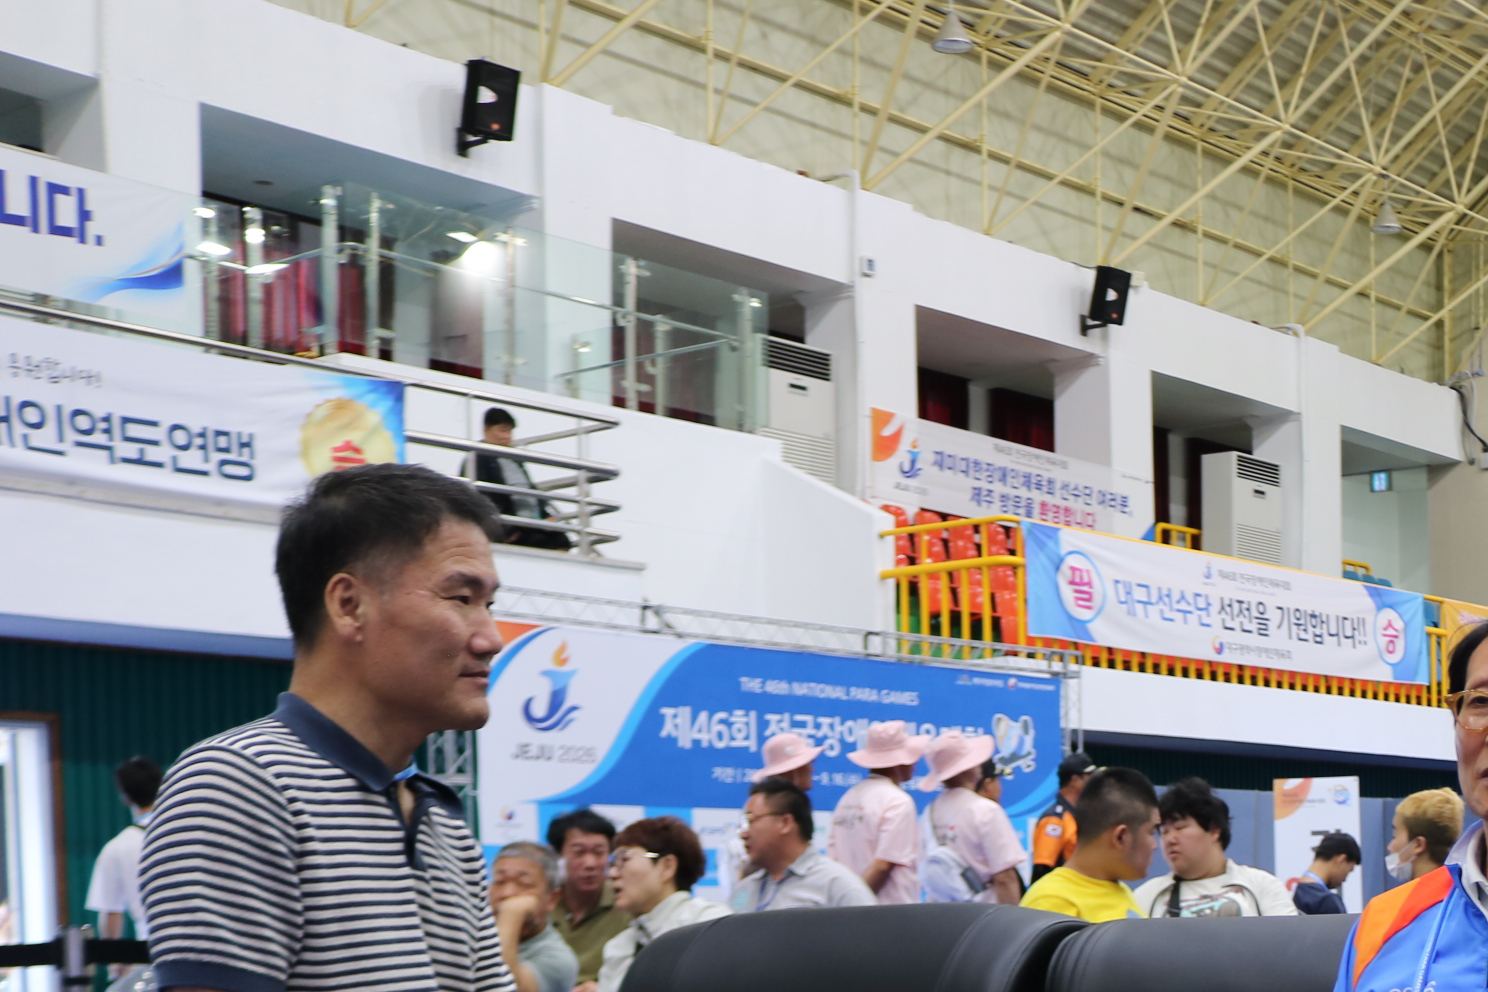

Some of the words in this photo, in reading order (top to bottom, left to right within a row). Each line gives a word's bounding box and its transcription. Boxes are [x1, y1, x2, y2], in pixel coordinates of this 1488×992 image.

[1067, 565, 1094, 610] 필
[1113, 577, 1212, 628] 대구선수단
[1218, 596, 1271, 637] 선전을
[1276, 605, 1367, 648] 기원합니다!!
[1382, 619, 1400, 655] 승
[738, 676, 764, 694] THE
[791, 681, 848, 701] NATIONAL
[880, 689, 920, 706] GAMES
[659, 705, 758, 753] 제46회
[510, 741, 554, 761] JEJU
